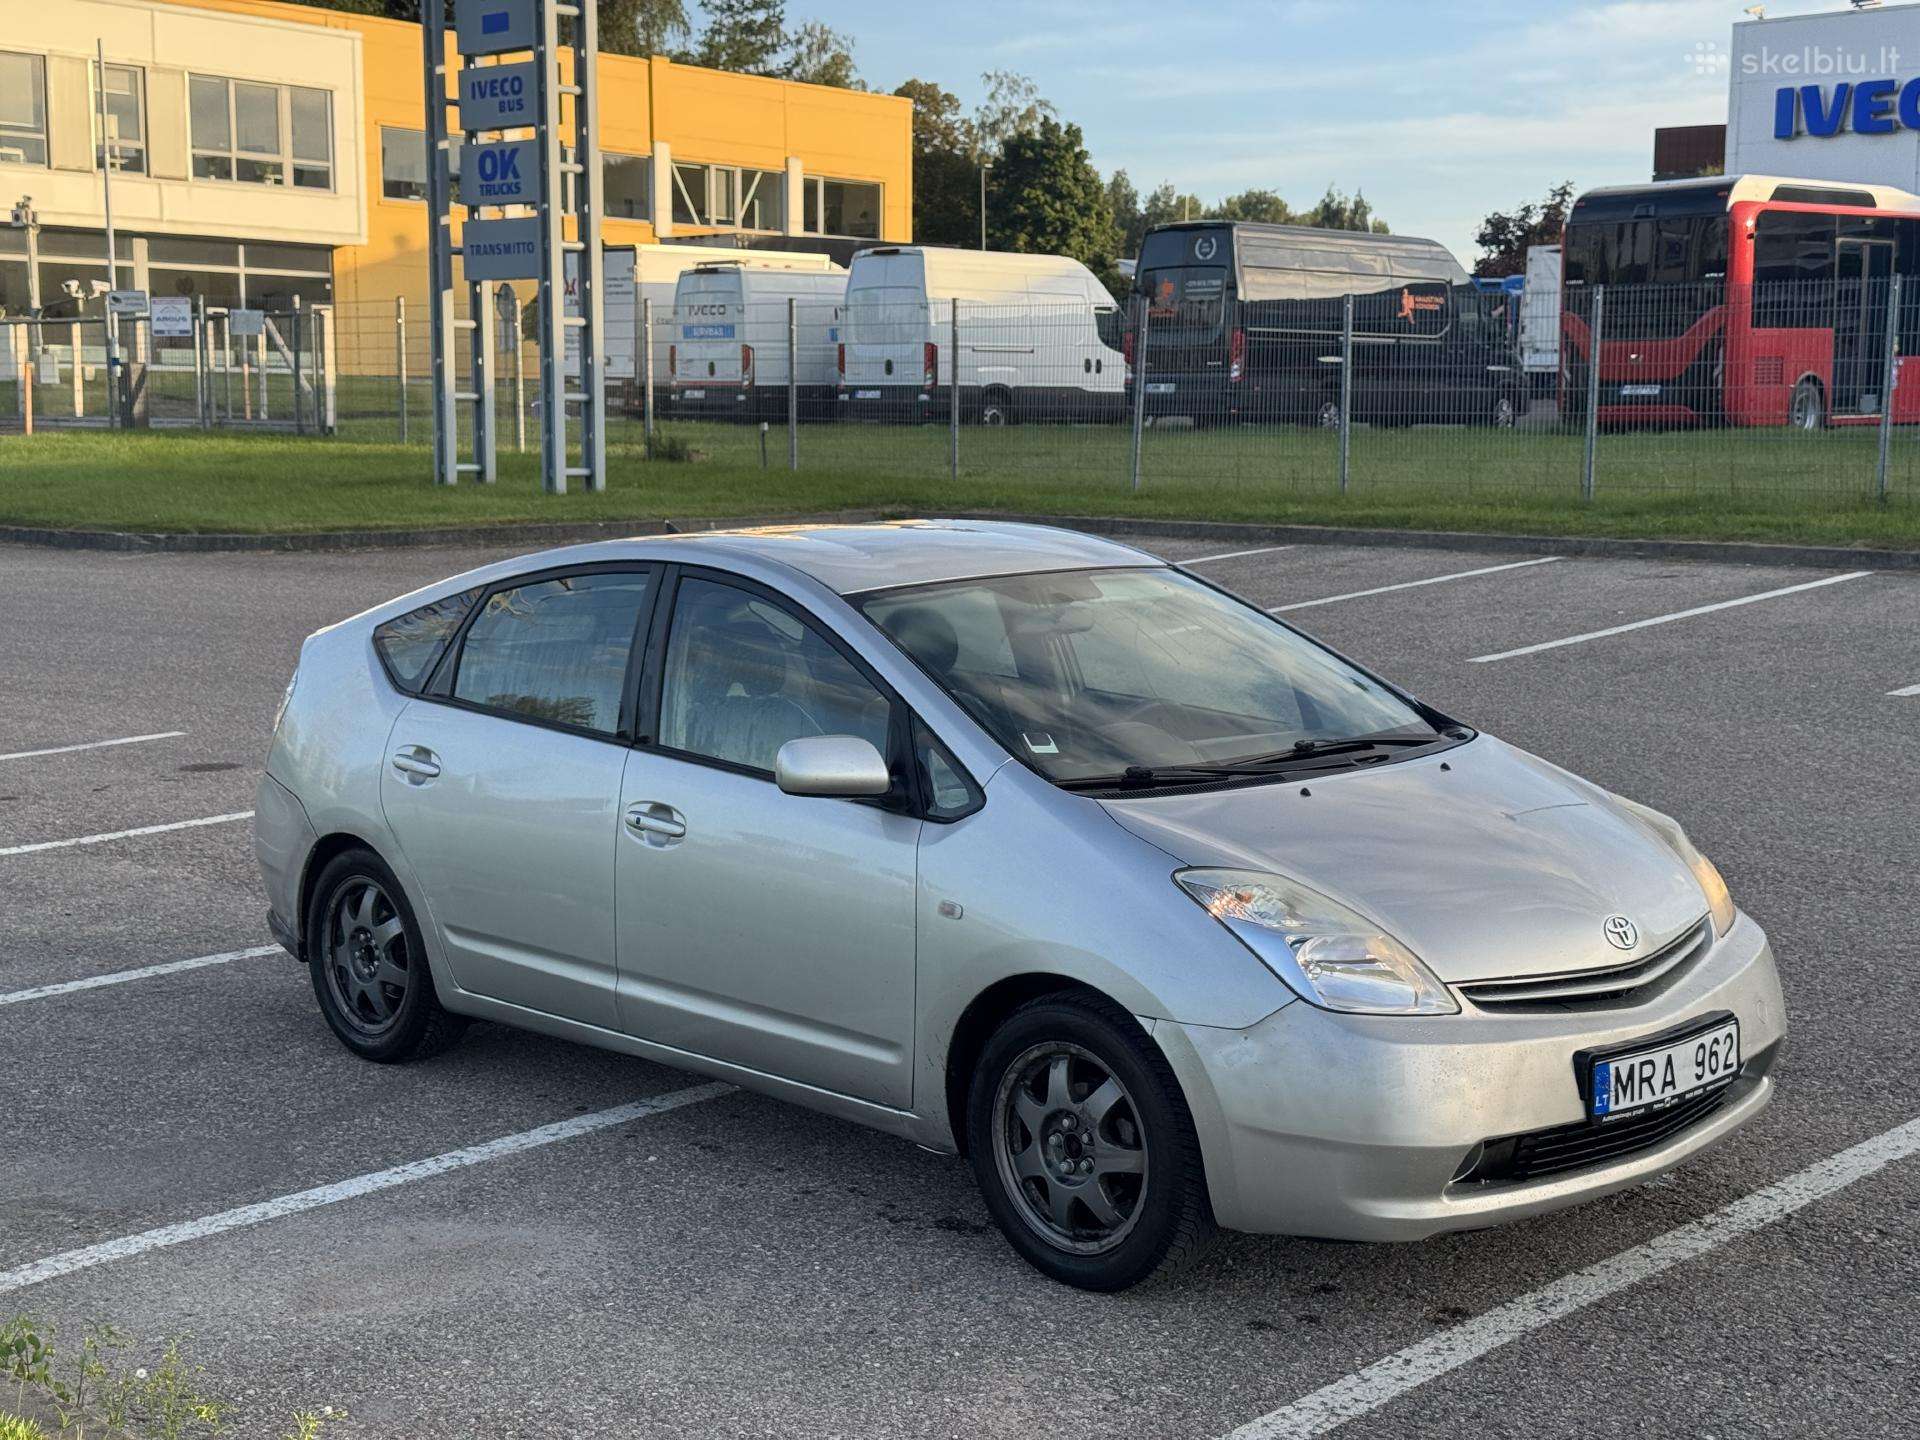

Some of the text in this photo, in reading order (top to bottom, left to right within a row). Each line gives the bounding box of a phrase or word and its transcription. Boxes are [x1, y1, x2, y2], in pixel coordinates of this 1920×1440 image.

[470, 75, 524, 100] IVECO
[498, 98, 524, 114] BUS
[478, 147, 521, 182] OK
[479, 181, 522, 197] TRUCKS
[469, 241, 535, 257] TRANSMITTO
[1614, 1032, 1734, 1106] MRA 962
[1595, 1094, 1609, 1107] LT
